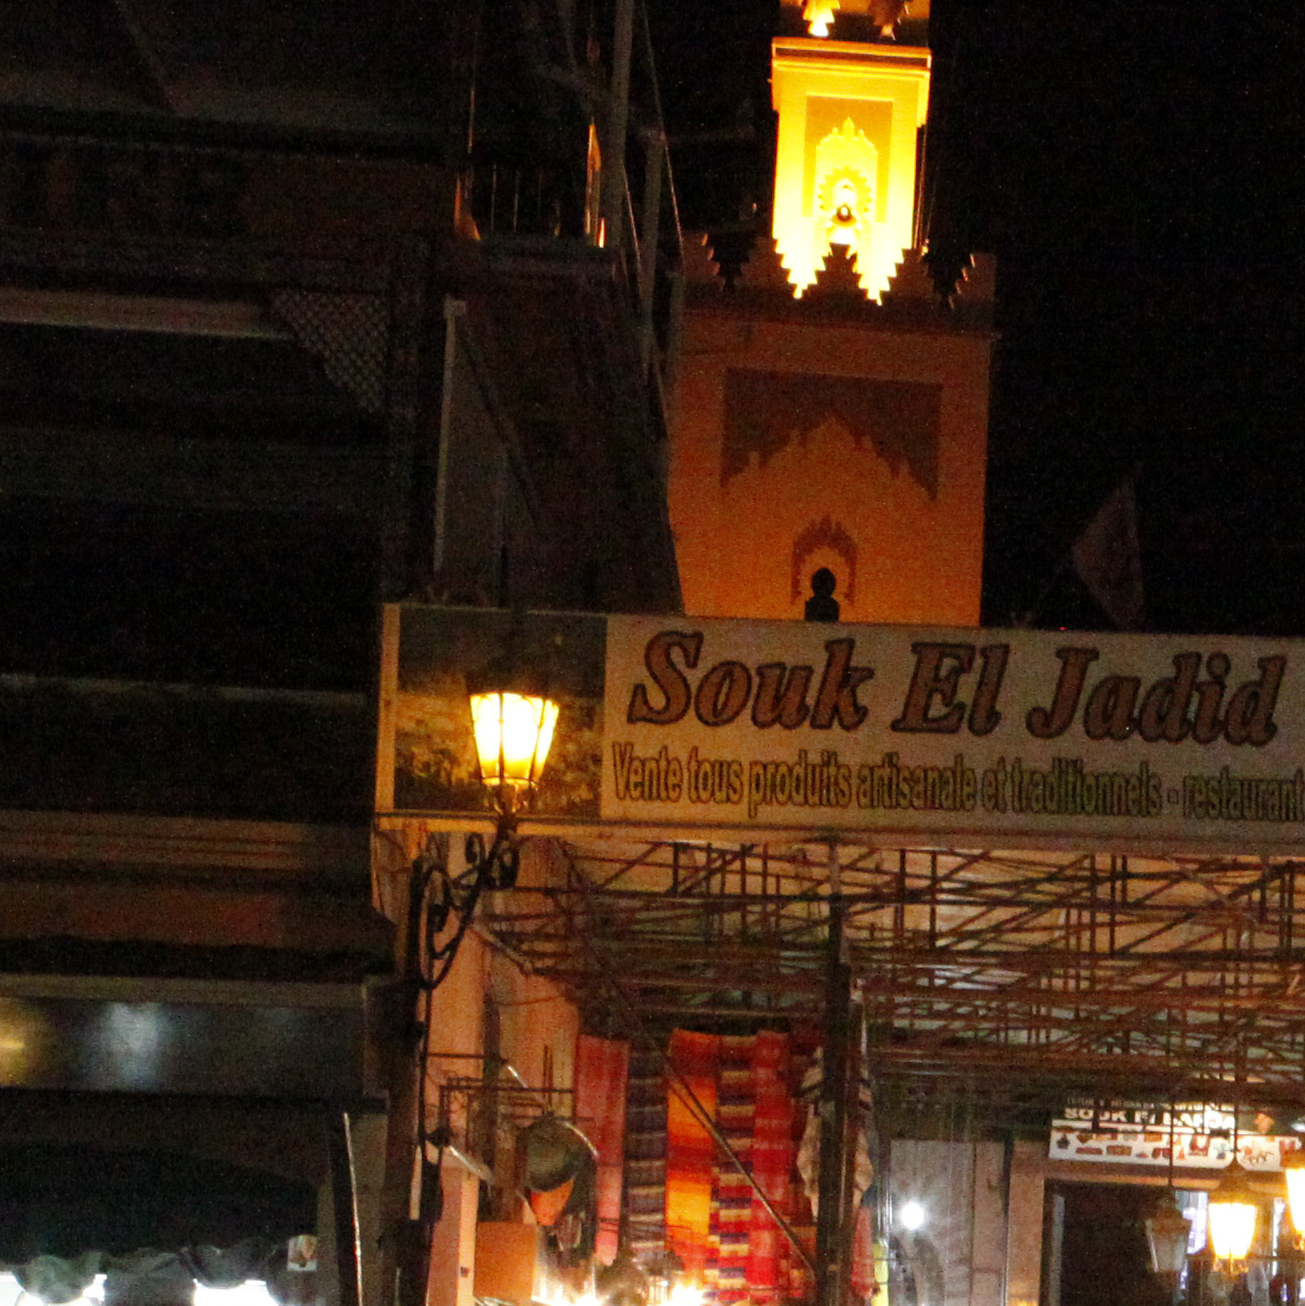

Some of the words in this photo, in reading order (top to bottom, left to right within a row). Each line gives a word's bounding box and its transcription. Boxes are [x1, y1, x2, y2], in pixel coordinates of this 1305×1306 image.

[627, 631, 875, 731] Souk
[890, 642, 1010, 737] El
[1025, 647, 1287, 747] Jadid
[612, 741, 683, 802] Vente
[687, 746, 744, 805] tous
[748, 750, 852, 819] produits
[857, 752, 977, 811] artisanale
[981, 756, 1006, 815] et
[1011, 757, 1163, 818] traditionnels
[1183, 765, 1305, 822] restaurant
